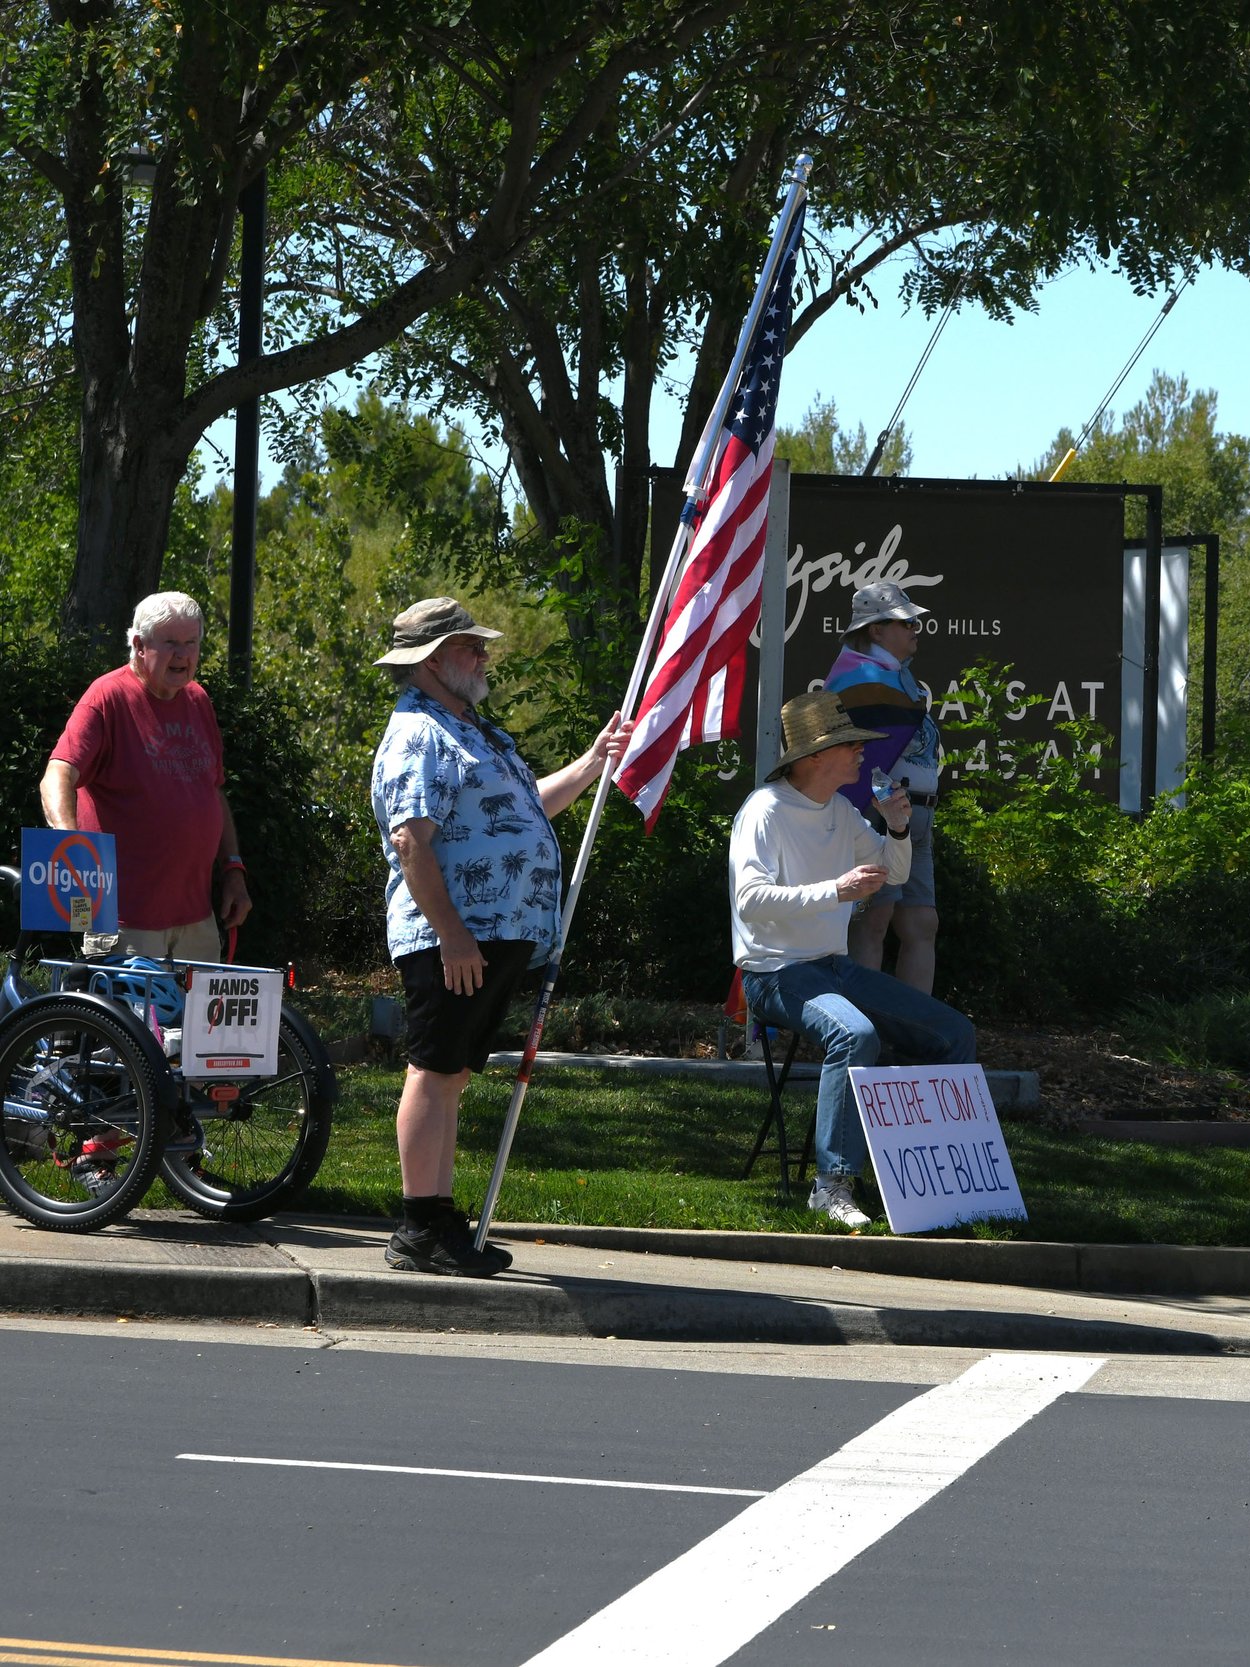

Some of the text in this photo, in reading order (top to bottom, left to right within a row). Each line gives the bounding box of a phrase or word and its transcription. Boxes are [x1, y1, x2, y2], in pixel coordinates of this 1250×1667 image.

[785, 523, 944, 646] yside
[823, 617, 845, 634] EL
[948, 618, 1001, 636] HILLS
[1046, 681, 1105, 721] AT
[208, 978, 259, 996] HANDS
[207, 997, 259, 1027] OFF!
[859, 1080, 932, 1128] RETIRE
[928, 1078, 978, 1123] TOM
[883, 1141, 1010, 1200] VOTE BLUE
